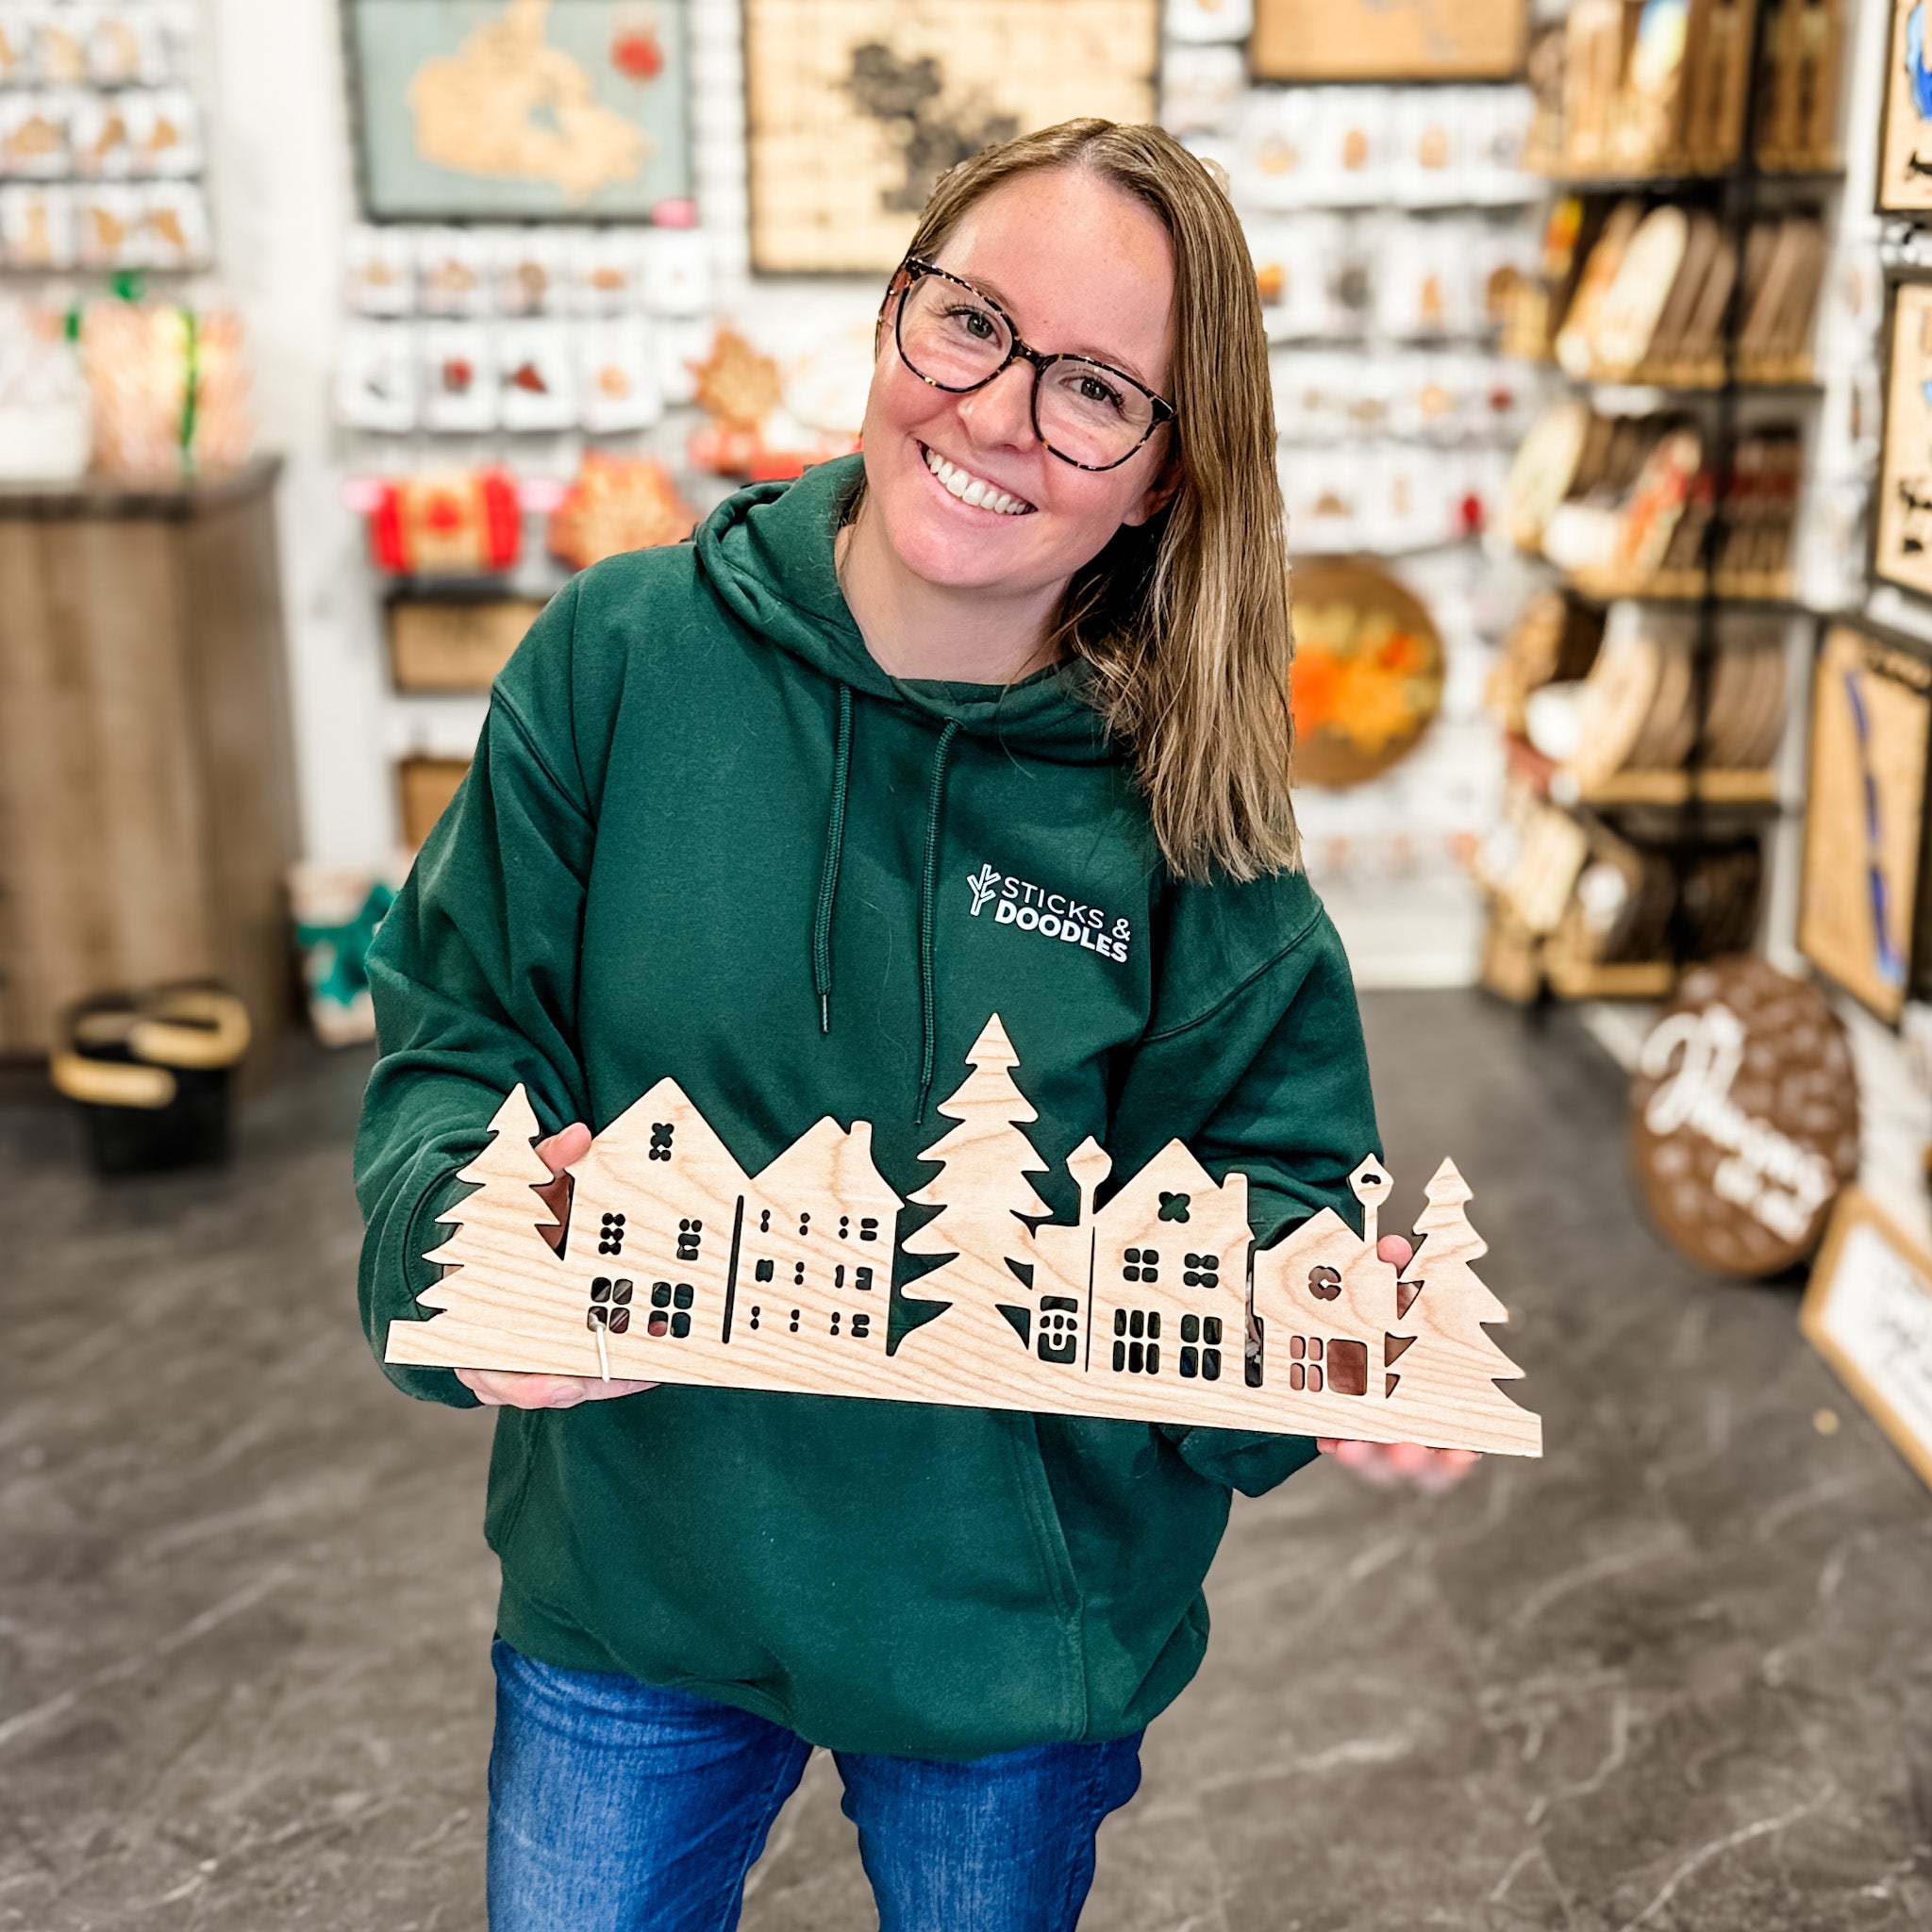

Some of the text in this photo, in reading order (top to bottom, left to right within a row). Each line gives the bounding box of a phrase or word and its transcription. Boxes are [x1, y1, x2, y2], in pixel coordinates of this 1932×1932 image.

[994, 899, 1128, 963] DOODLES
[1001, 876, 1131, 941] STICKS &
